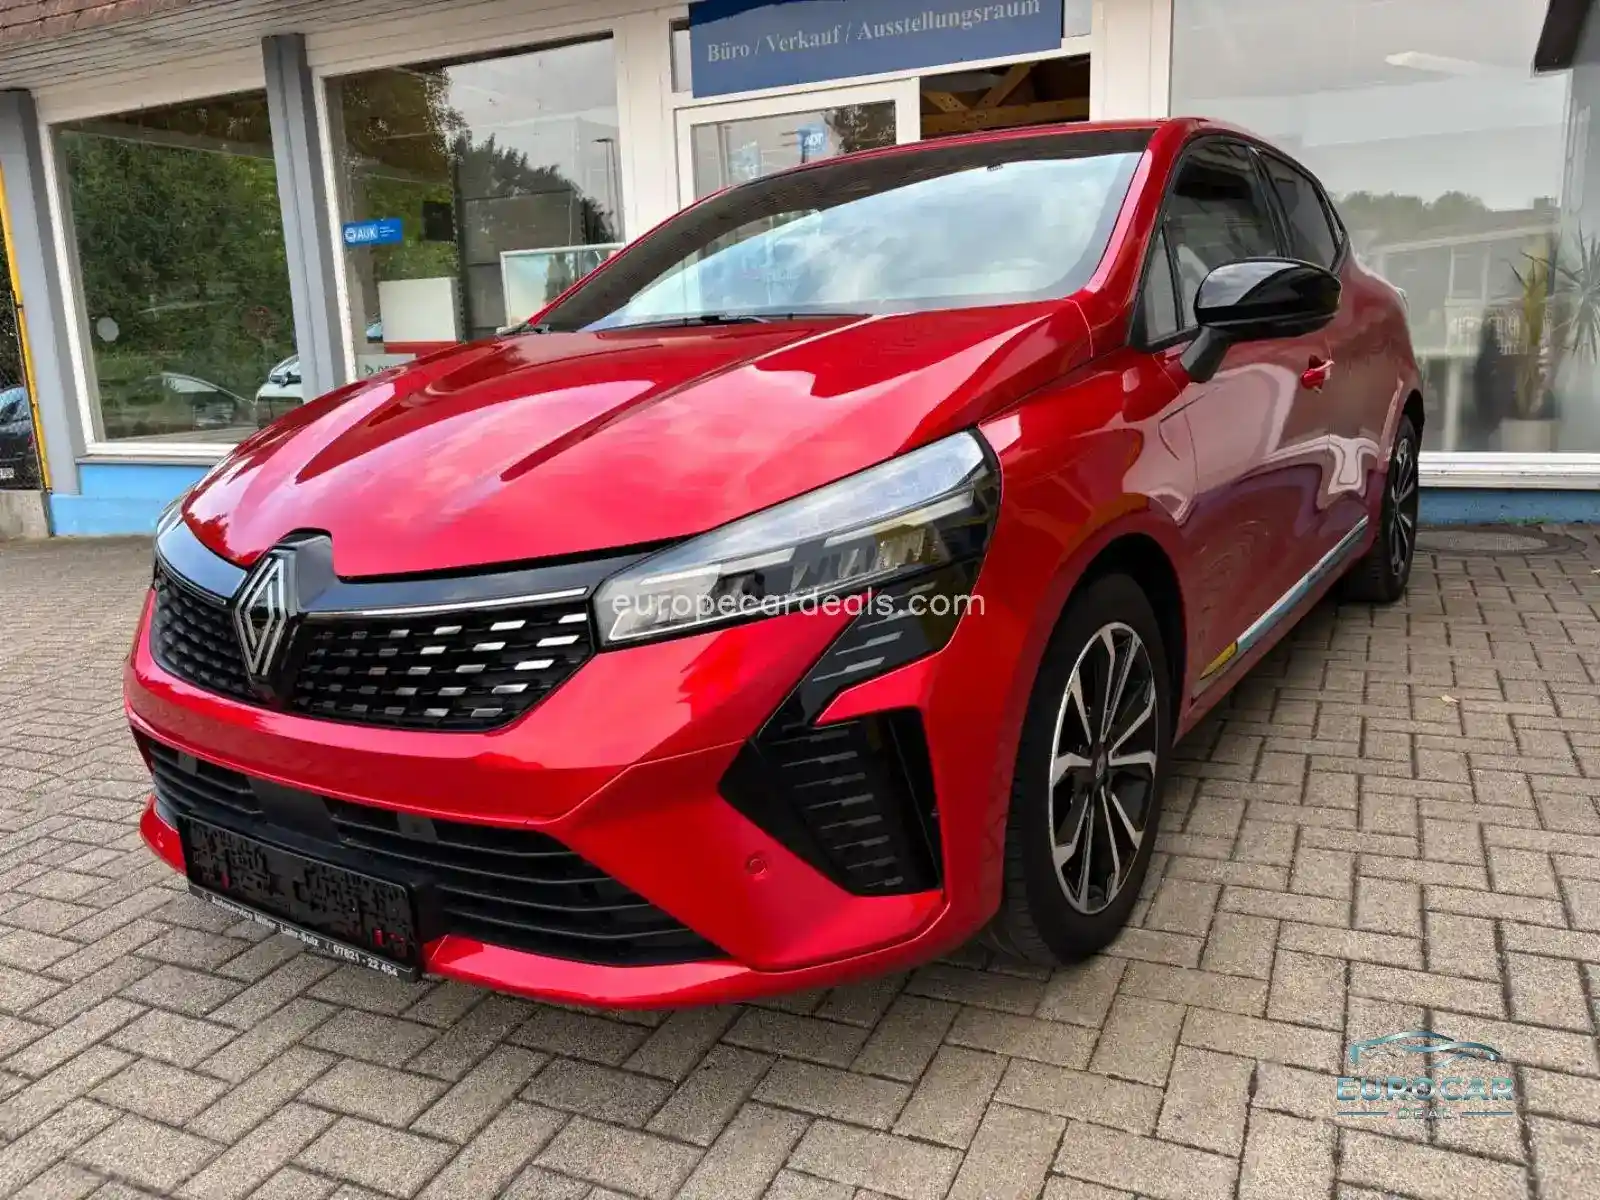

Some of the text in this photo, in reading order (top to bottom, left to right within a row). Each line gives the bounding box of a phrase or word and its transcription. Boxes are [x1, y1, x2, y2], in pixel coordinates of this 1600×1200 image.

[707, 43, 750, 62] Büro
[765, 25, 842, 52] Verkauf
[857, 0, 1040, 41] Ausstellungsraum
